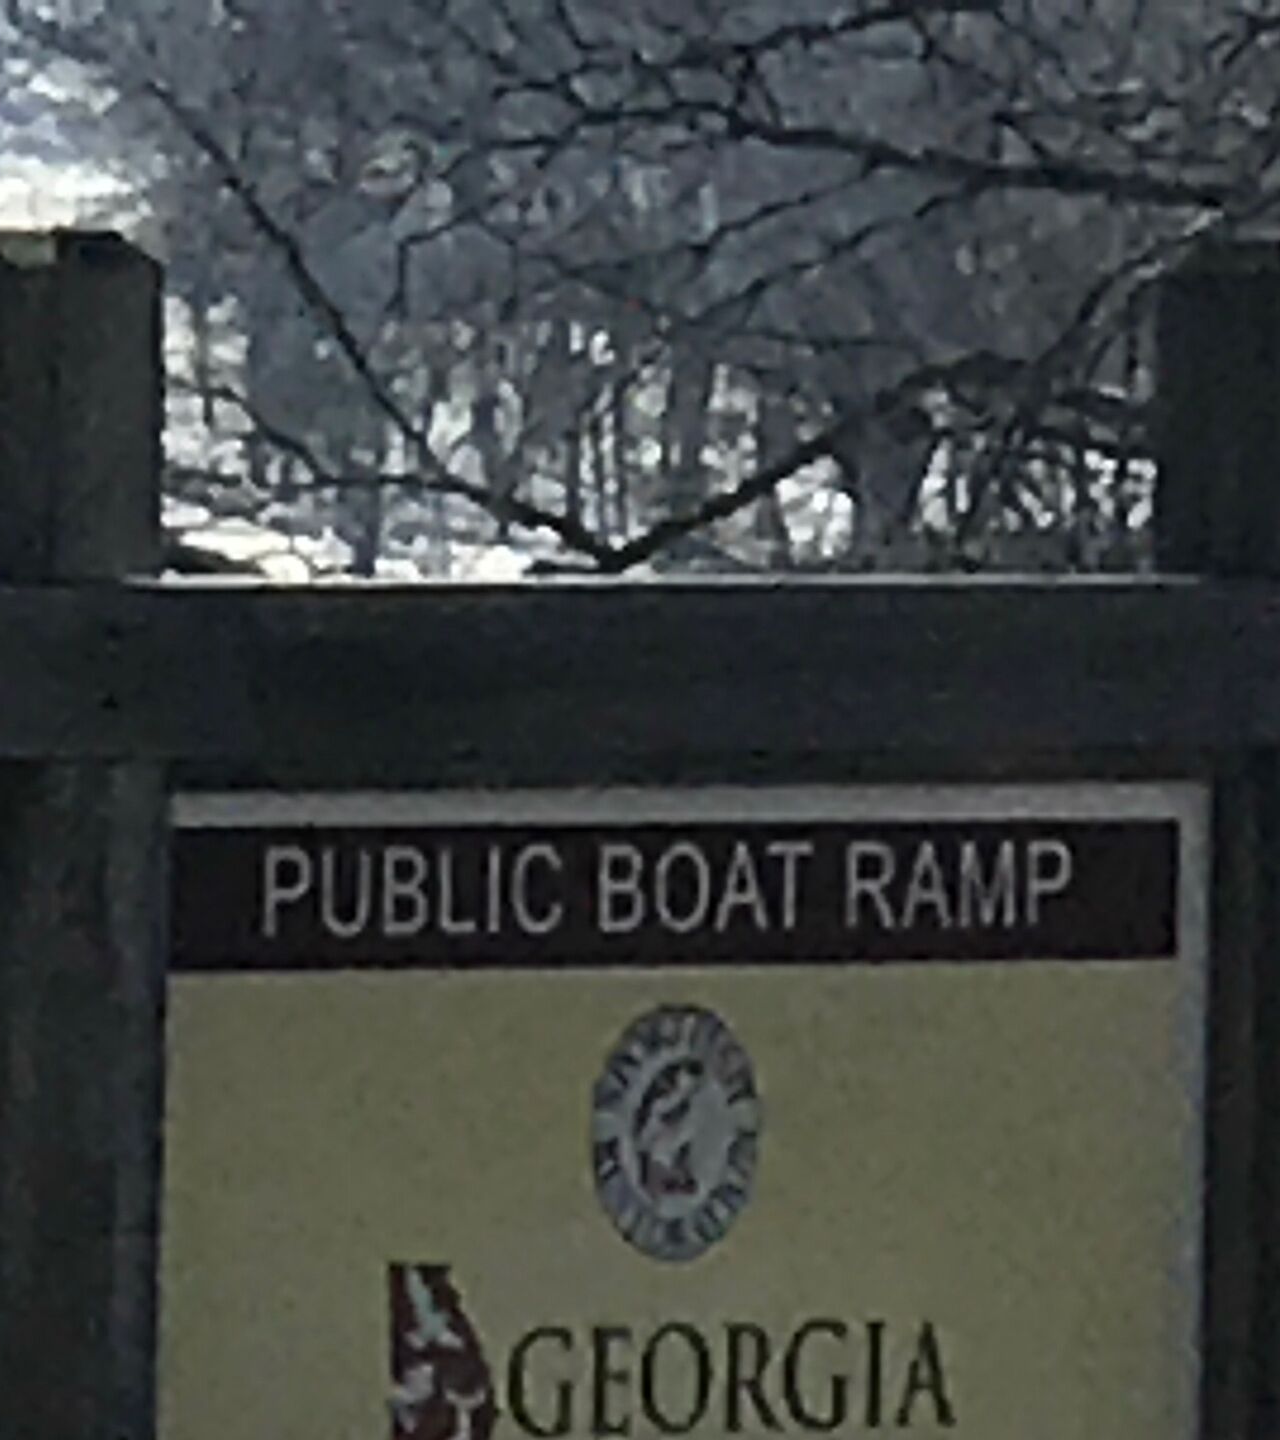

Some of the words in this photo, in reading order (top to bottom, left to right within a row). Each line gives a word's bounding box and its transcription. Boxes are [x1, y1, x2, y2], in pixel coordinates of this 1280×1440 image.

[261, 842, 564, 940] PUBLIC
[597, 838, 814, 934] BOAT
[842, 837, 1075, 931] RAMP
[506, 1317, 958, 1440] GEORGIA
